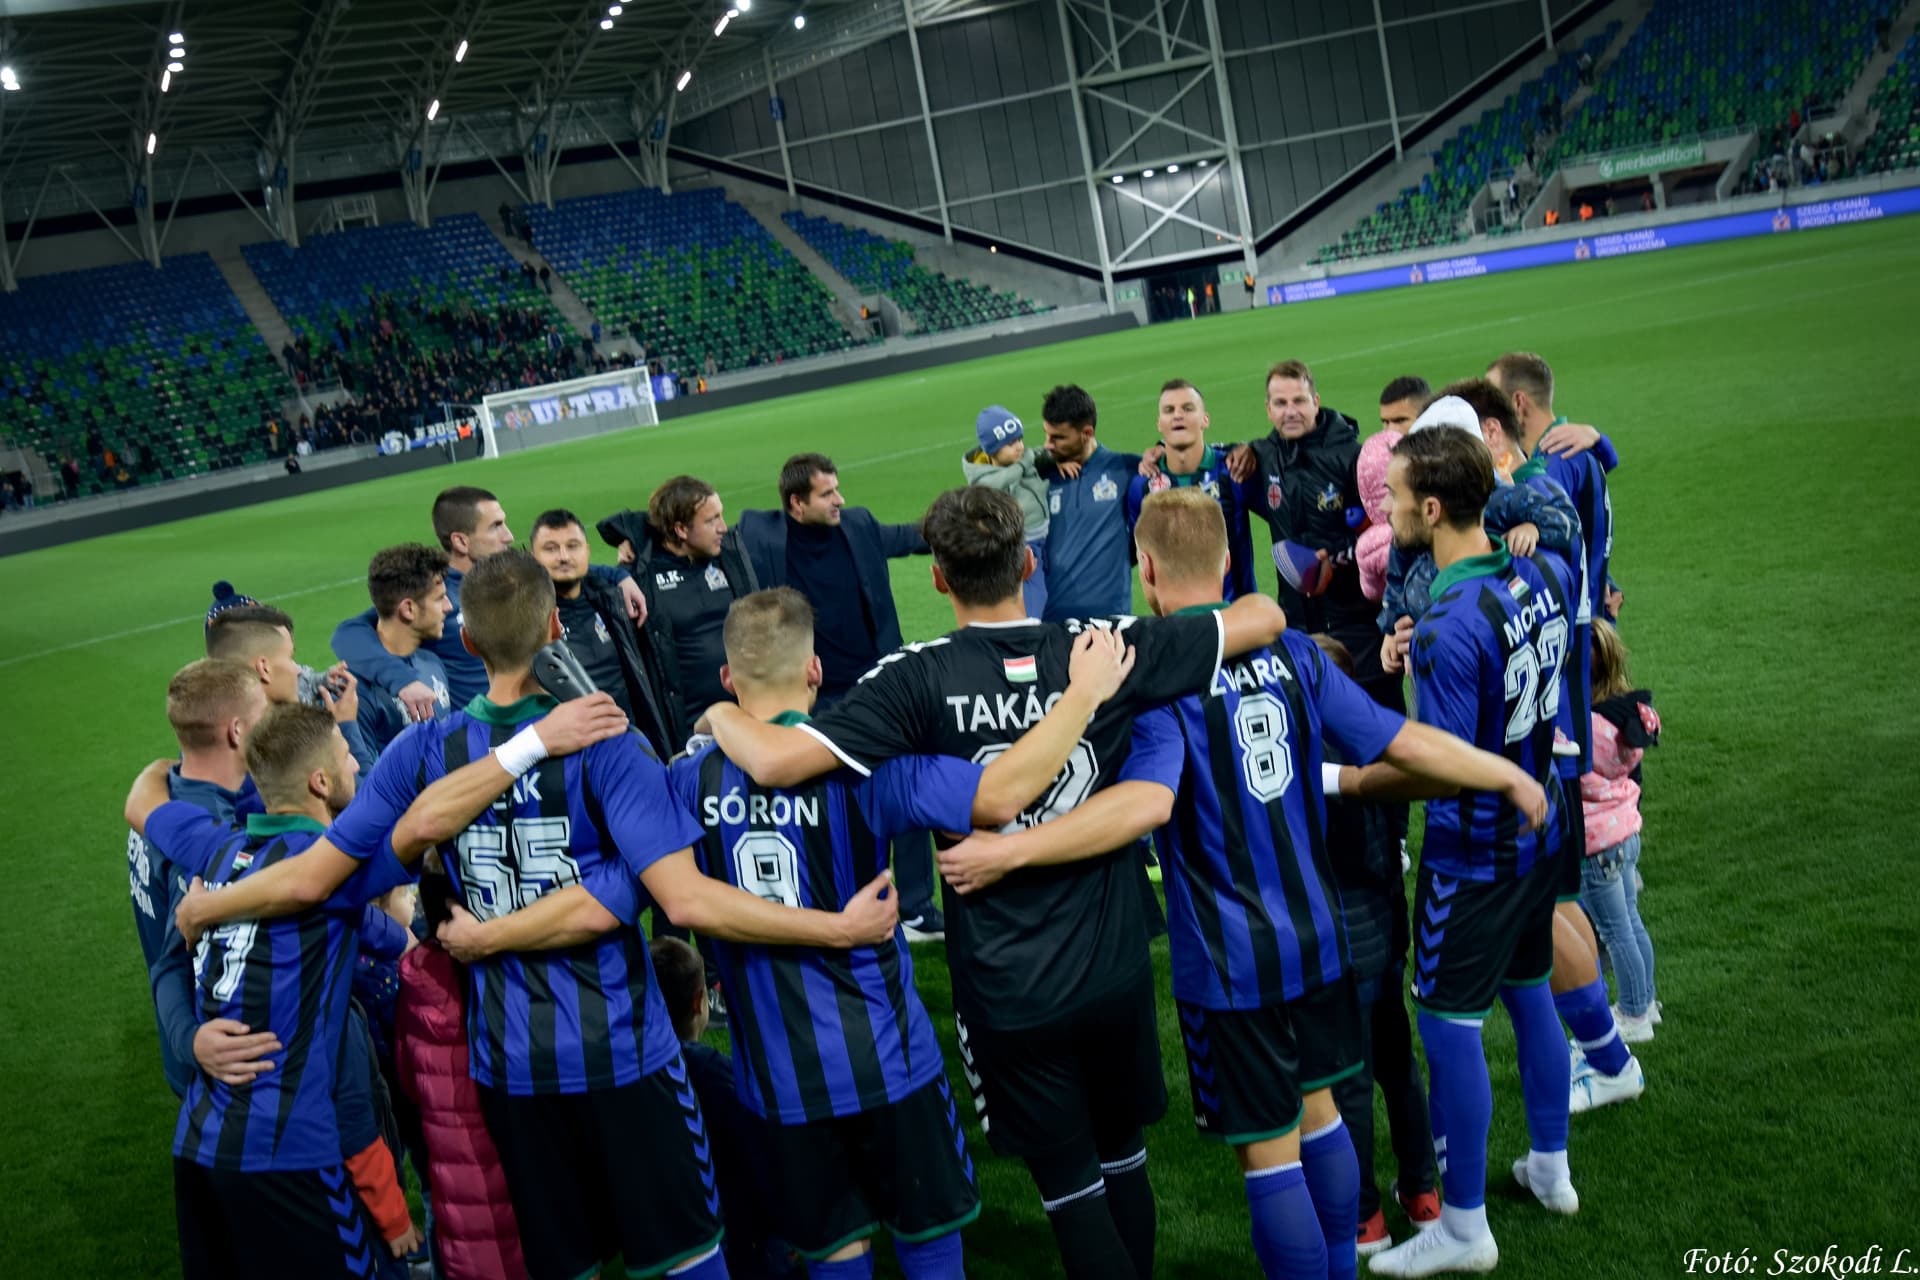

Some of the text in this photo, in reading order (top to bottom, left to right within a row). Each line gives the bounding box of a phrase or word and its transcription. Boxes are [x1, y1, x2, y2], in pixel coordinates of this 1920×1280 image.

[1503, 588, 1561, 649] MOHL
[1234, 691, 1289, 804] 8
[703, 785, 820, 827] SÓRON
[732, 830, 804, 909] 9
